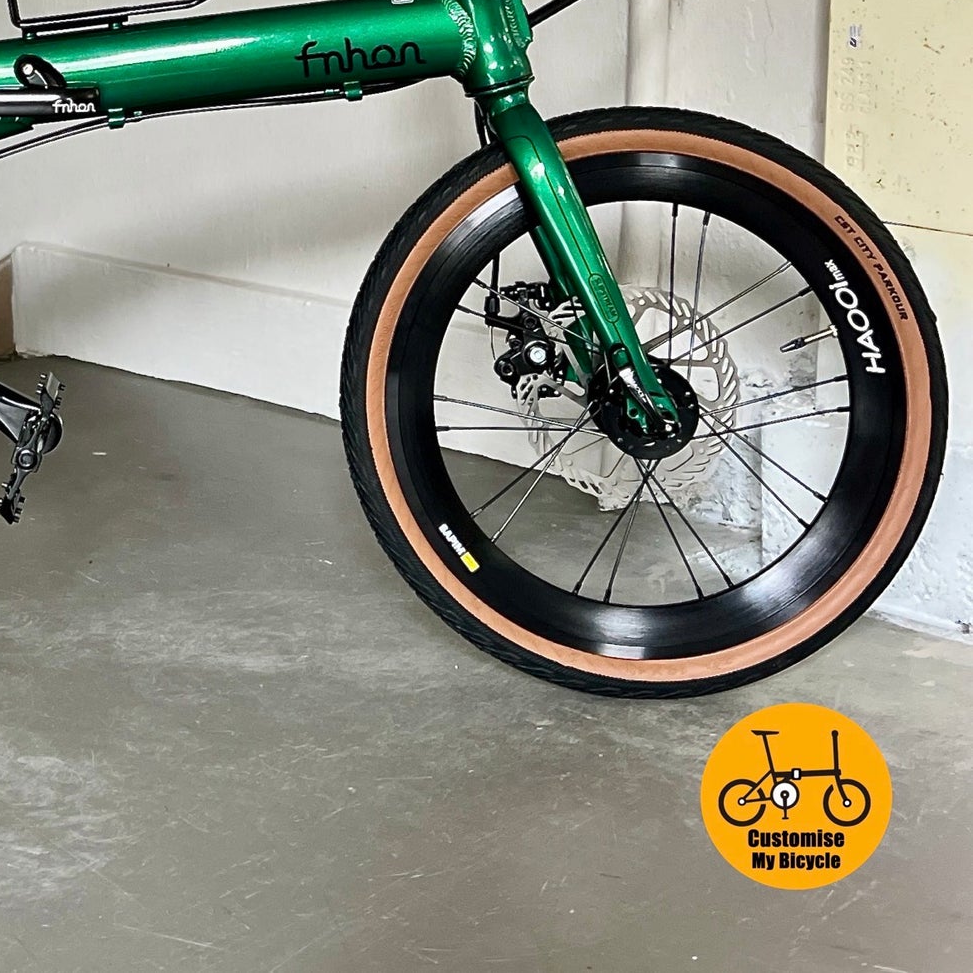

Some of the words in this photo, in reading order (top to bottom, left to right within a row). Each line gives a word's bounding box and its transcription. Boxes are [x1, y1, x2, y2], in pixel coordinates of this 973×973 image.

[834, 215, 856, 235] CST
[853, 235, 878, 260] CITY
[873, 263, 909, 321] PARKOUR
